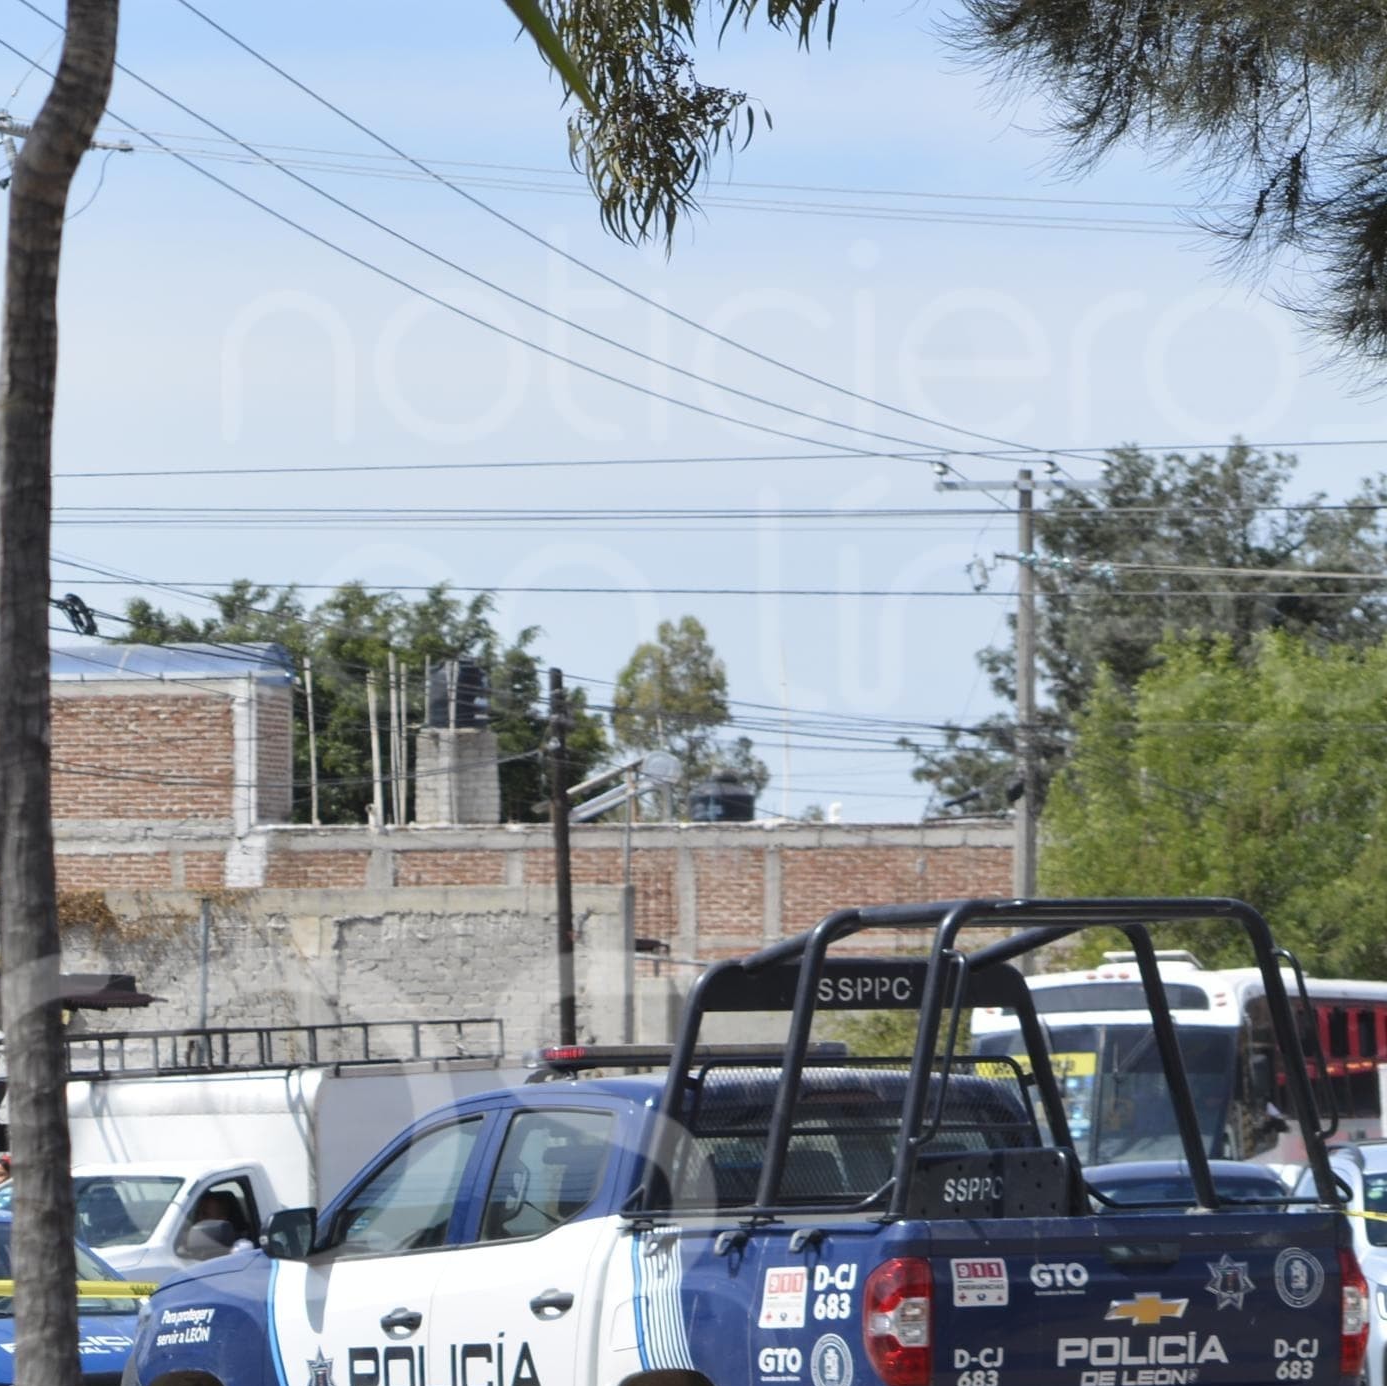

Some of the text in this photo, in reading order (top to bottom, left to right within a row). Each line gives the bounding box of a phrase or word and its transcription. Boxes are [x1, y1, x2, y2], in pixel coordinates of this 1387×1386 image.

[816, 976, 912, 1002] SSPPC
[943, 1177, 1004, 1202] SSPPC
[813, 1263, 857, 1291] D-CJ
[957, 1262, 1001, 1279] 911
[1029, 1262, 1089, 1288] GTO
[813, 1292, 851, 1320] 683
[185, 1322, 211, 1344] LEÓN
[758, 1347, 803, 1373] GTO
[953, 1347, 1004, 1369] D-CJ
[1056, 1331, 1230, 1367] POLICÍA
[1273, 1338, 1319, 1359] D-CJ
[1080, 1369, 1188, 1386] DE LEÓN
[1275, 1360, 1315, 1380] 683
